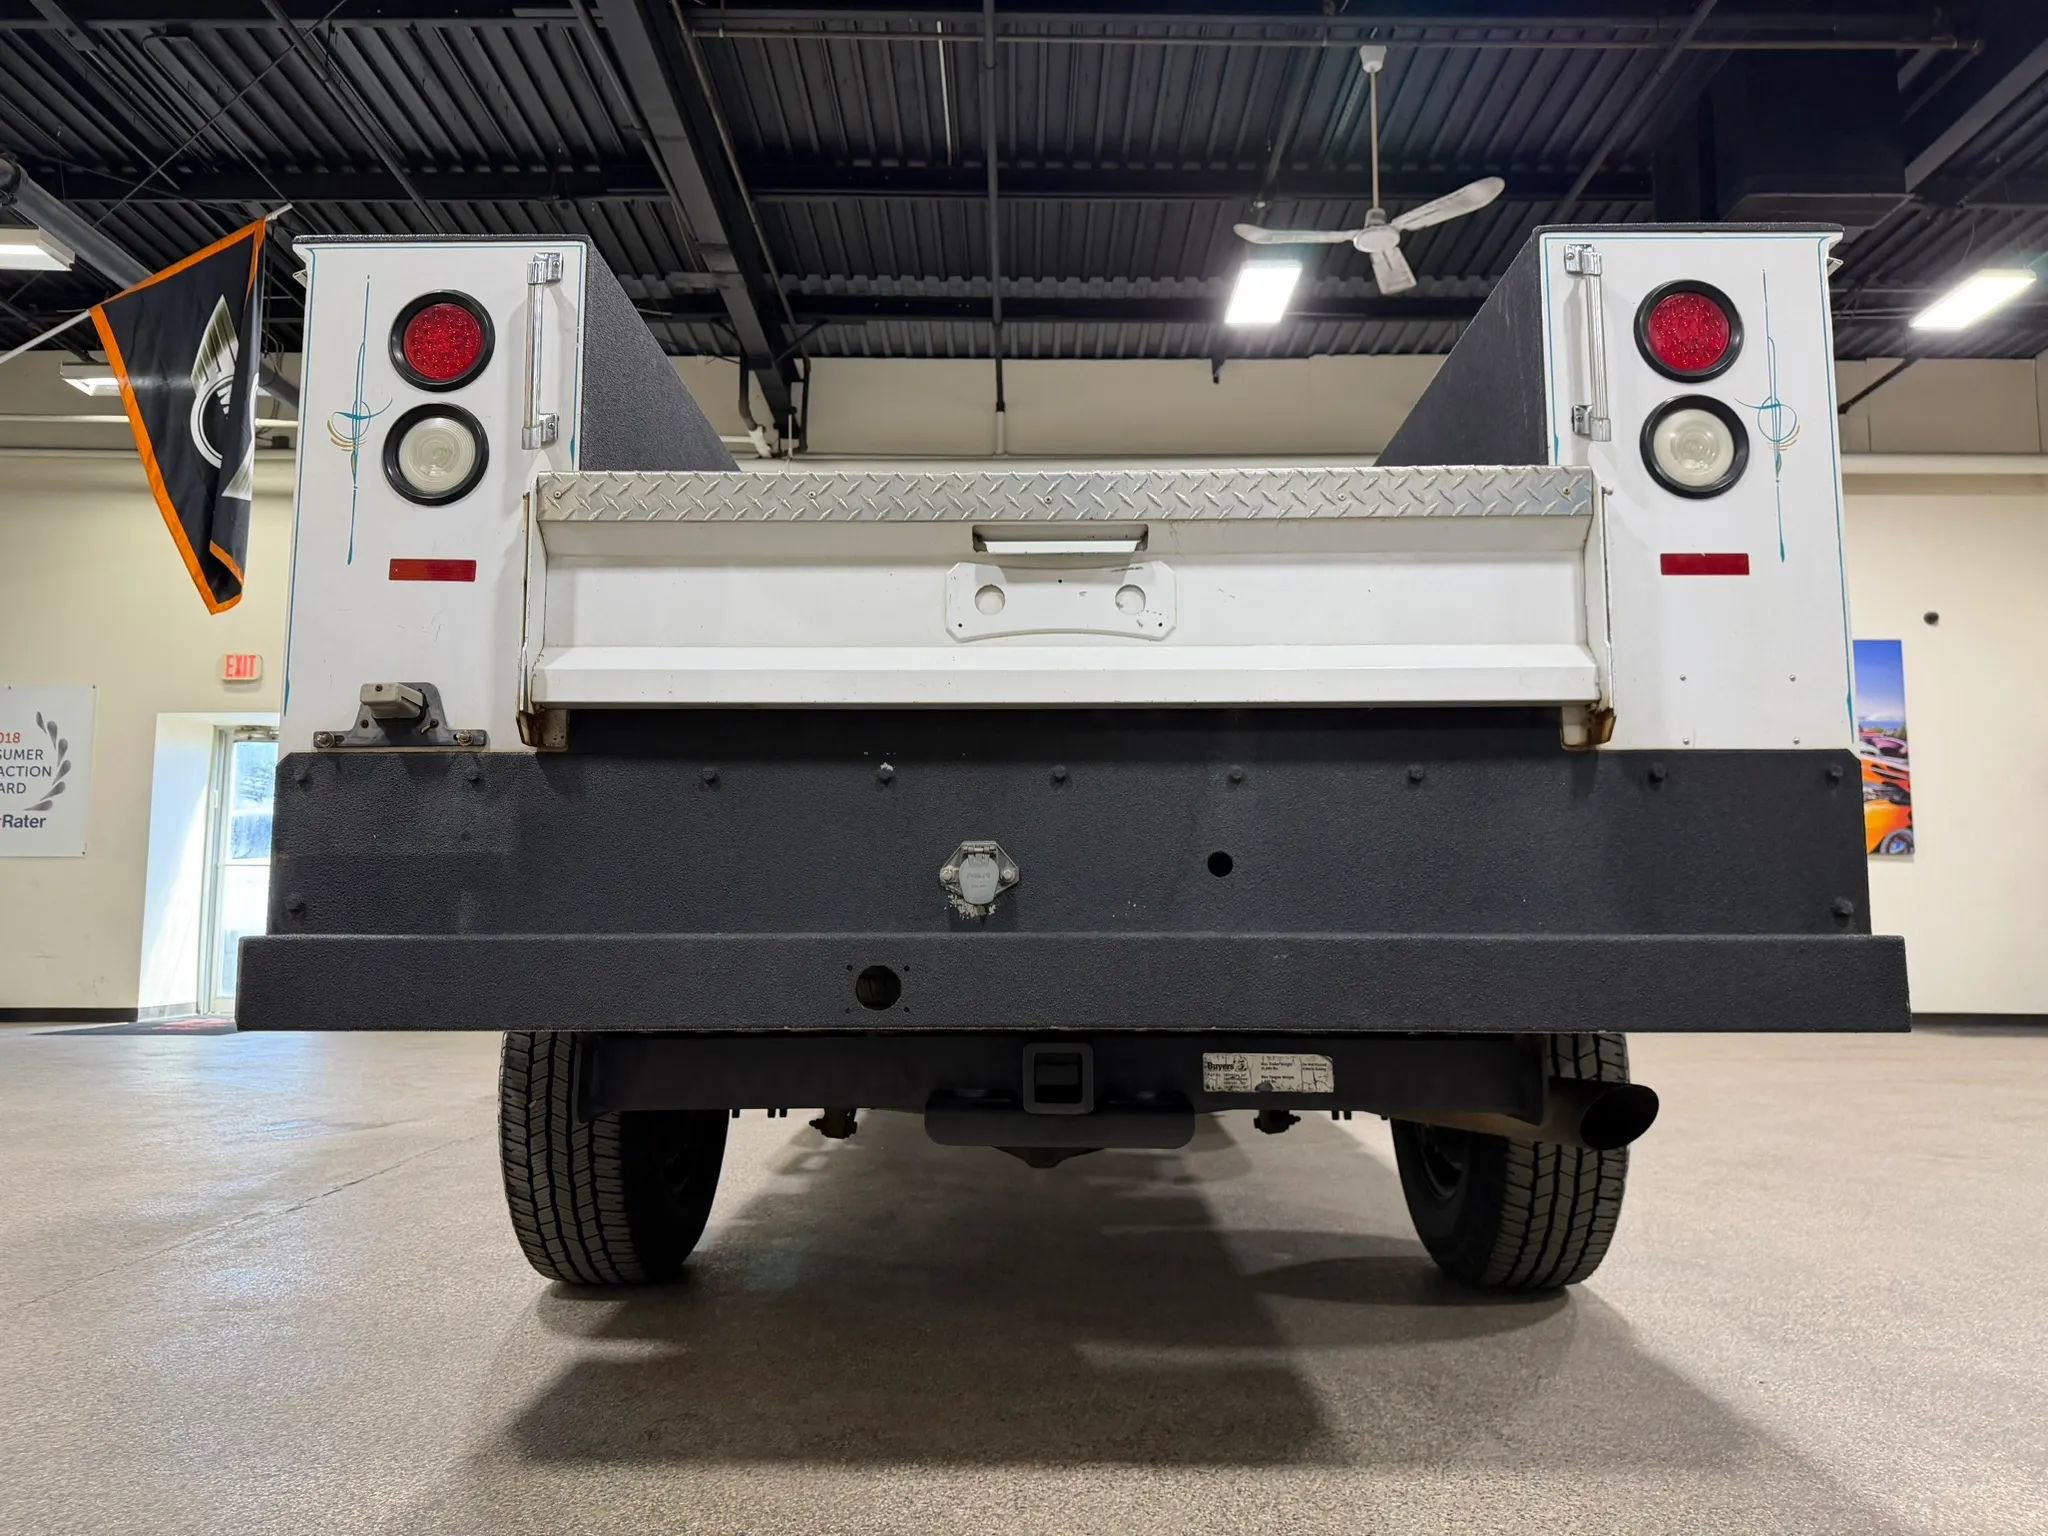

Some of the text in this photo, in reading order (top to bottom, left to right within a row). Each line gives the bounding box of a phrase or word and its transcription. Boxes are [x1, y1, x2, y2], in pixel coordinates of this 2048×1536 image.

[226, 655, 257, 677] EXIT
[0, 749, 44, 760] UMER
[0, 813, 47, 828] Rater
[1207, 1061, 1234, 1071] Buyers
